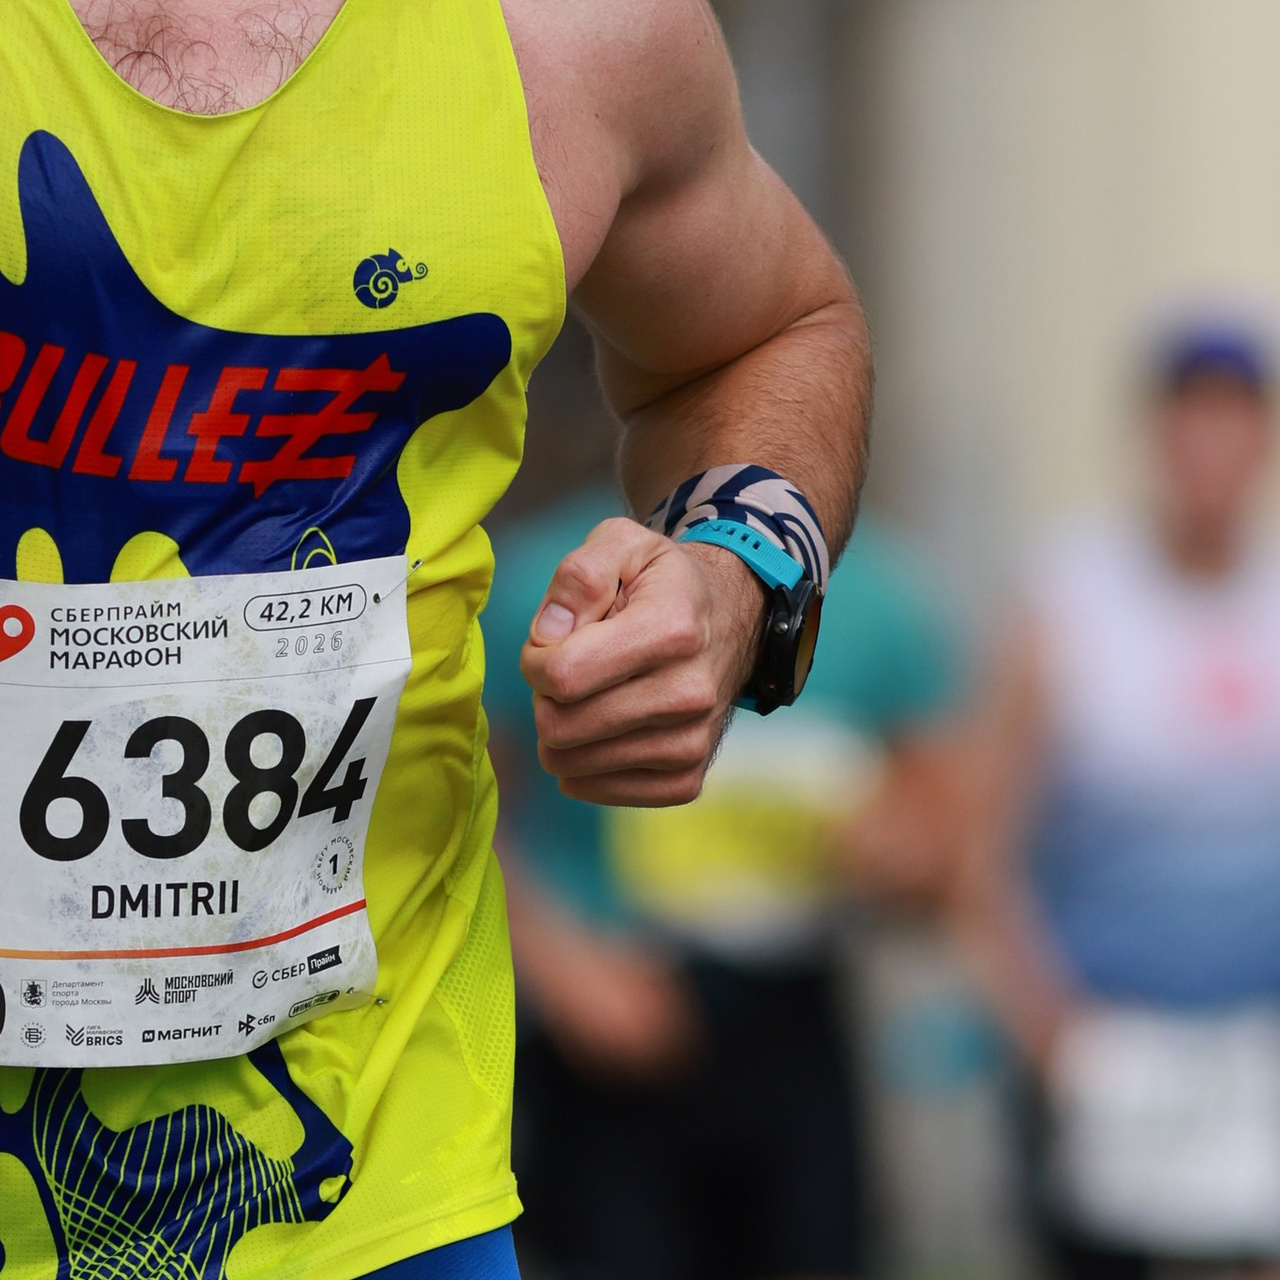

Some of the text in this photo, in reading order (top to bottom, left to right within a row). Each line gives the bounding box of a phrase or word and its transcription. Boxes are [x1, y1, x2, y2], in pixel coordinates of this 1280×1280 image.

[51, 600, 181, 622] СБЕРПРАЙМ
[260, 598, 311, 623] 42,2
[50, 616, 228, 646] МОСКОВСКИЙ
[275, 631, 342, 657] 2026
[50, 646, 182, 670] МАРАФОН
[329, 853, 338, 876] 1
[91, 880, 238, 919] DMITRII
[165, 968, 233, 990] МОСКОВСКИЙ
[272, 953, 336, 982] СБЕР Прайм
[52, 981, 104, 989] Департамент
[81, 998, 112, 1006] Москвы
[164, 990, 197, 1004] СПОРТ
[86, 1035, 123, 1046] BRICS
